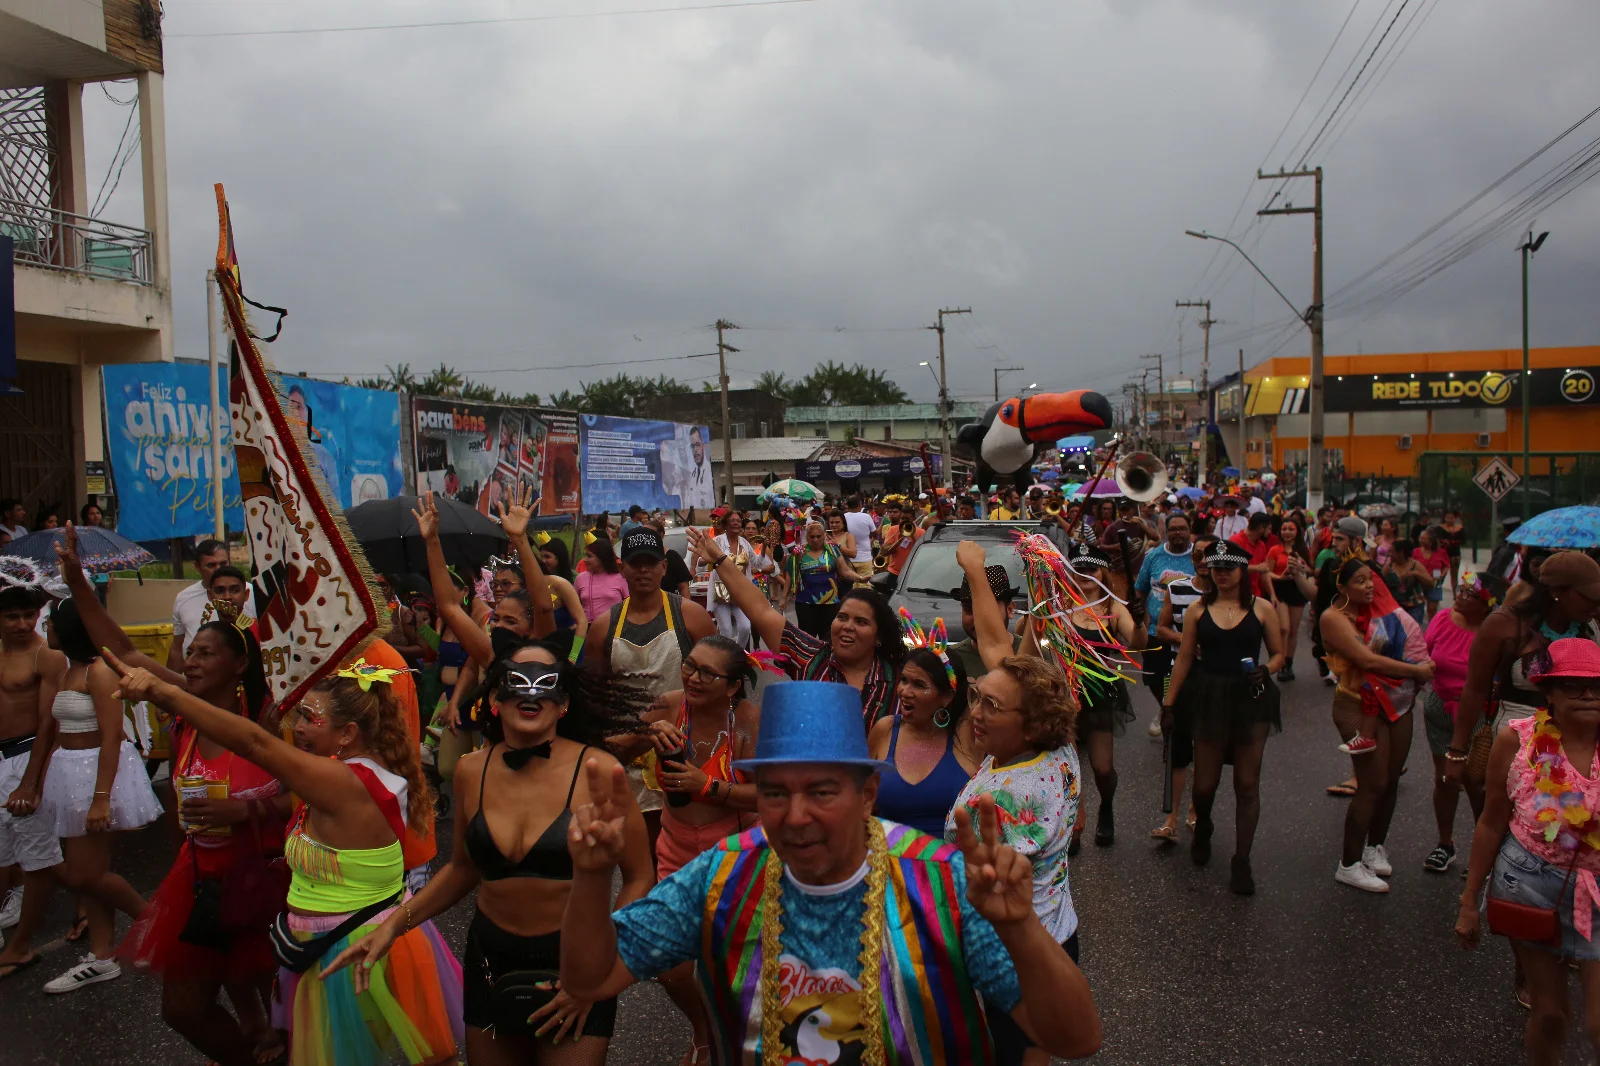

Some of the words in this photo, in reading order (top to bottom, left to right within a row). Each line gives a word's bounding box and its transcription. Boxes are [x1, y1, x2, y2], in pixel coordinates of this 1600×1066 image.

[141, 382, 173, 401] Feliz
[1372, 381, 1421, 400] REDE
[1428, 379, 1481, 398] TUDO
[1564, 379, 1592, 395] 20
[417, 407, 485, 432] parabéns
[262, 645, 291, 677] 997
